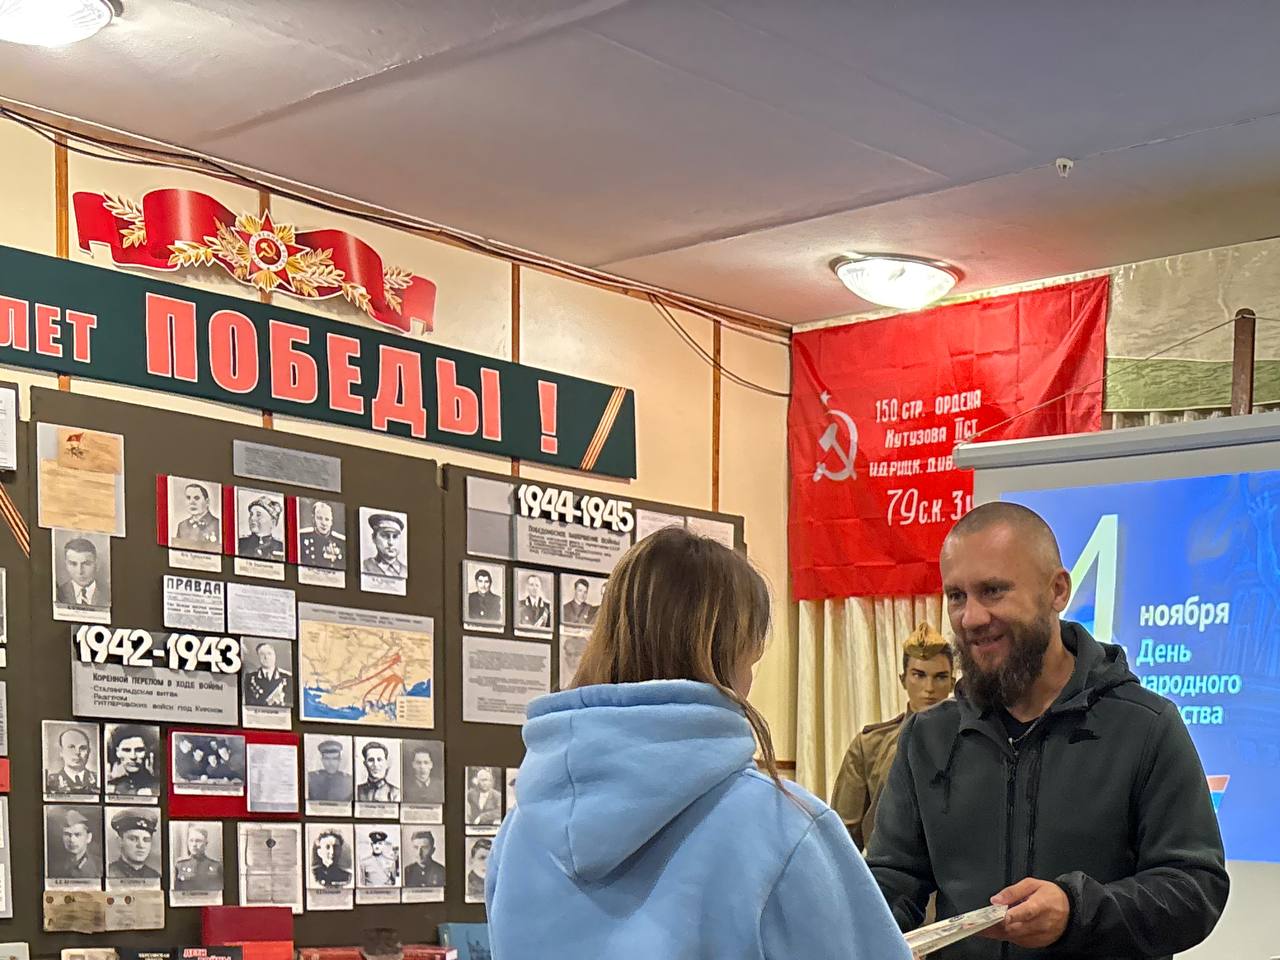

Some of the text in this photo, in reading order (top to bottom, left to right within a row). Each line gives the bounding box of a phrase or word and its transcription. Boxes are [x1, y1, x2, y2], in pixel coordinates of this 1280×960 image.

[0, 294, 97, 364] ЛЕТ
[145, 292, 502, 440] ПОБЕДЫ
[875, 398, 898, 423] 150
[935, 389, 981, 415] ОРДЕНА
[518, 484, 634, 532] 1944-1945
[166, 577, 221, 595] ПРАВДА
[1140, 595, 1230, 632] ноября
[76, 625, 242, 674] 1942-1943
[1136, 639, 1192, 667] День
